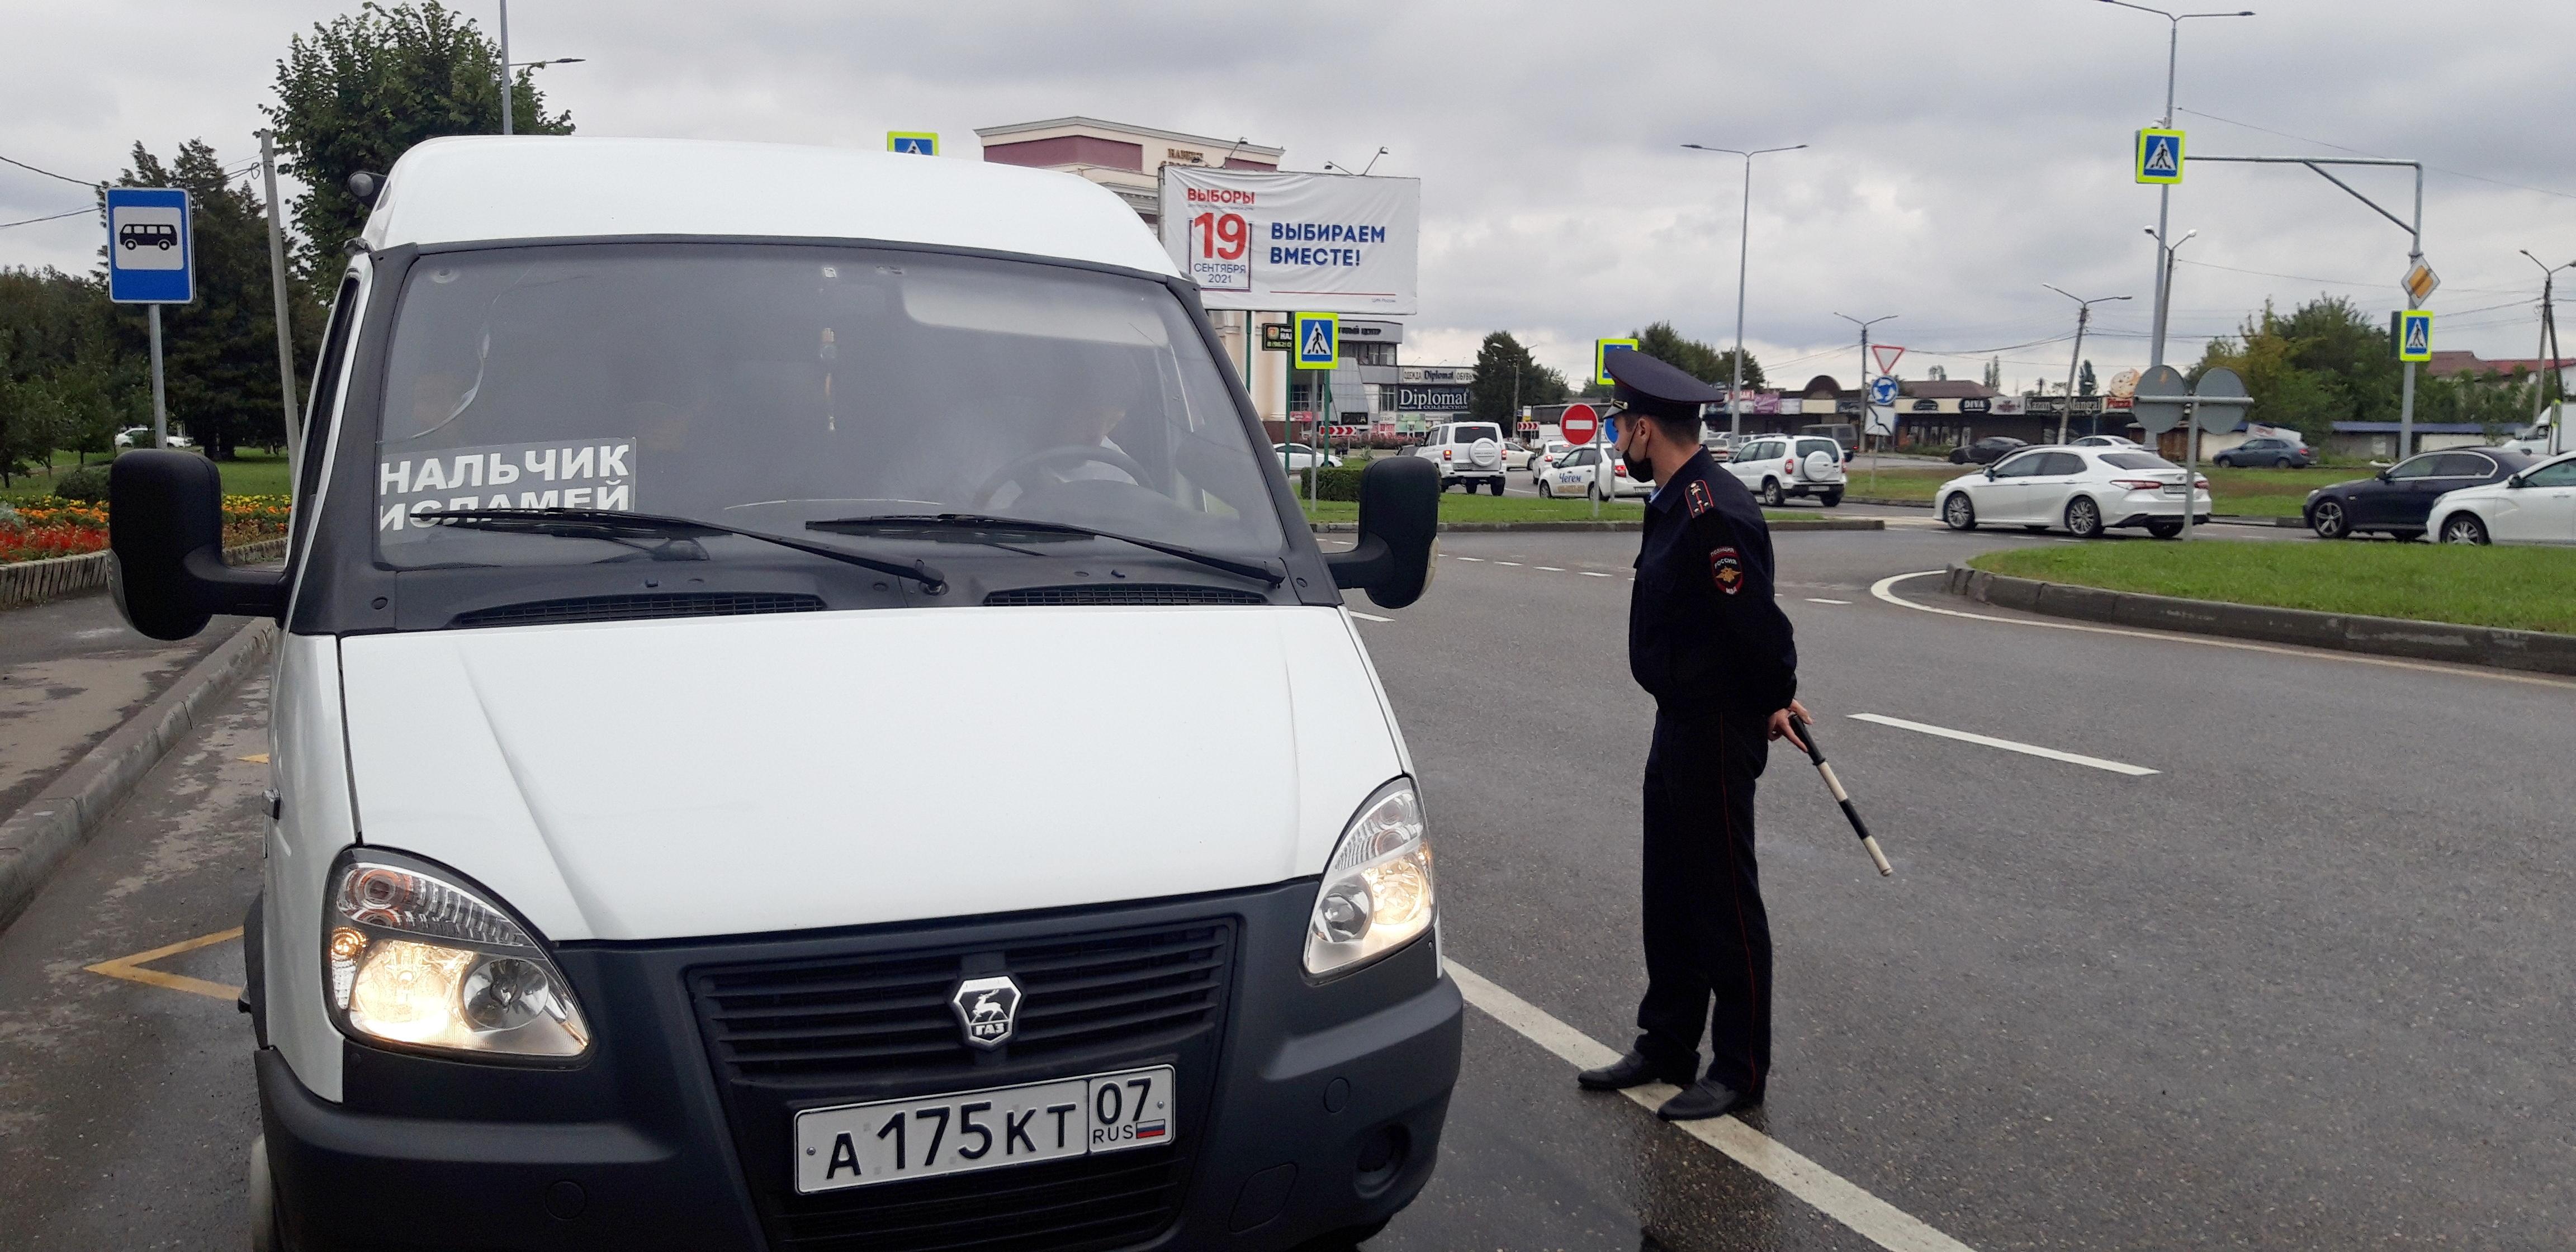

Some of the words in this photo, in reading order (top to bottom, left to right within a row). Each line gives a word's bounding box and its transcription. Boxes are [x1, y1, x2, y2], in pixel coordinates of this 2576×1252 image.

[1187, 188, 1255, 205] ВЫБОРЫ
[1195, 212, 1247, 260] 19
[1271, 222, 1386, 243] ВЫБИРАЕМ
[1270, 246, 1361, 267] ВМЕСТЕ!
[1194, 263, 1246, 274] СЕНТЯБРЯ
[1208, 273, 1233, 284] 2021
[1424, 370, 1453, 382] Diplomat
[1399, 388, 1469, 410] Diplomat
[1964, 400, 1985, 408] DIVA
[380, 444, 629, 496] НАЛЬЧИК
[1559, 472, 1581, 483] Чегем
[1714, 558, 1737, 569] РОССИЯ
[975, 1022, 1005, 1036] ГАЗ
[1096, 1076, 1152, 1126] 07
[1092, 1124, 1134, 1145] RUS
